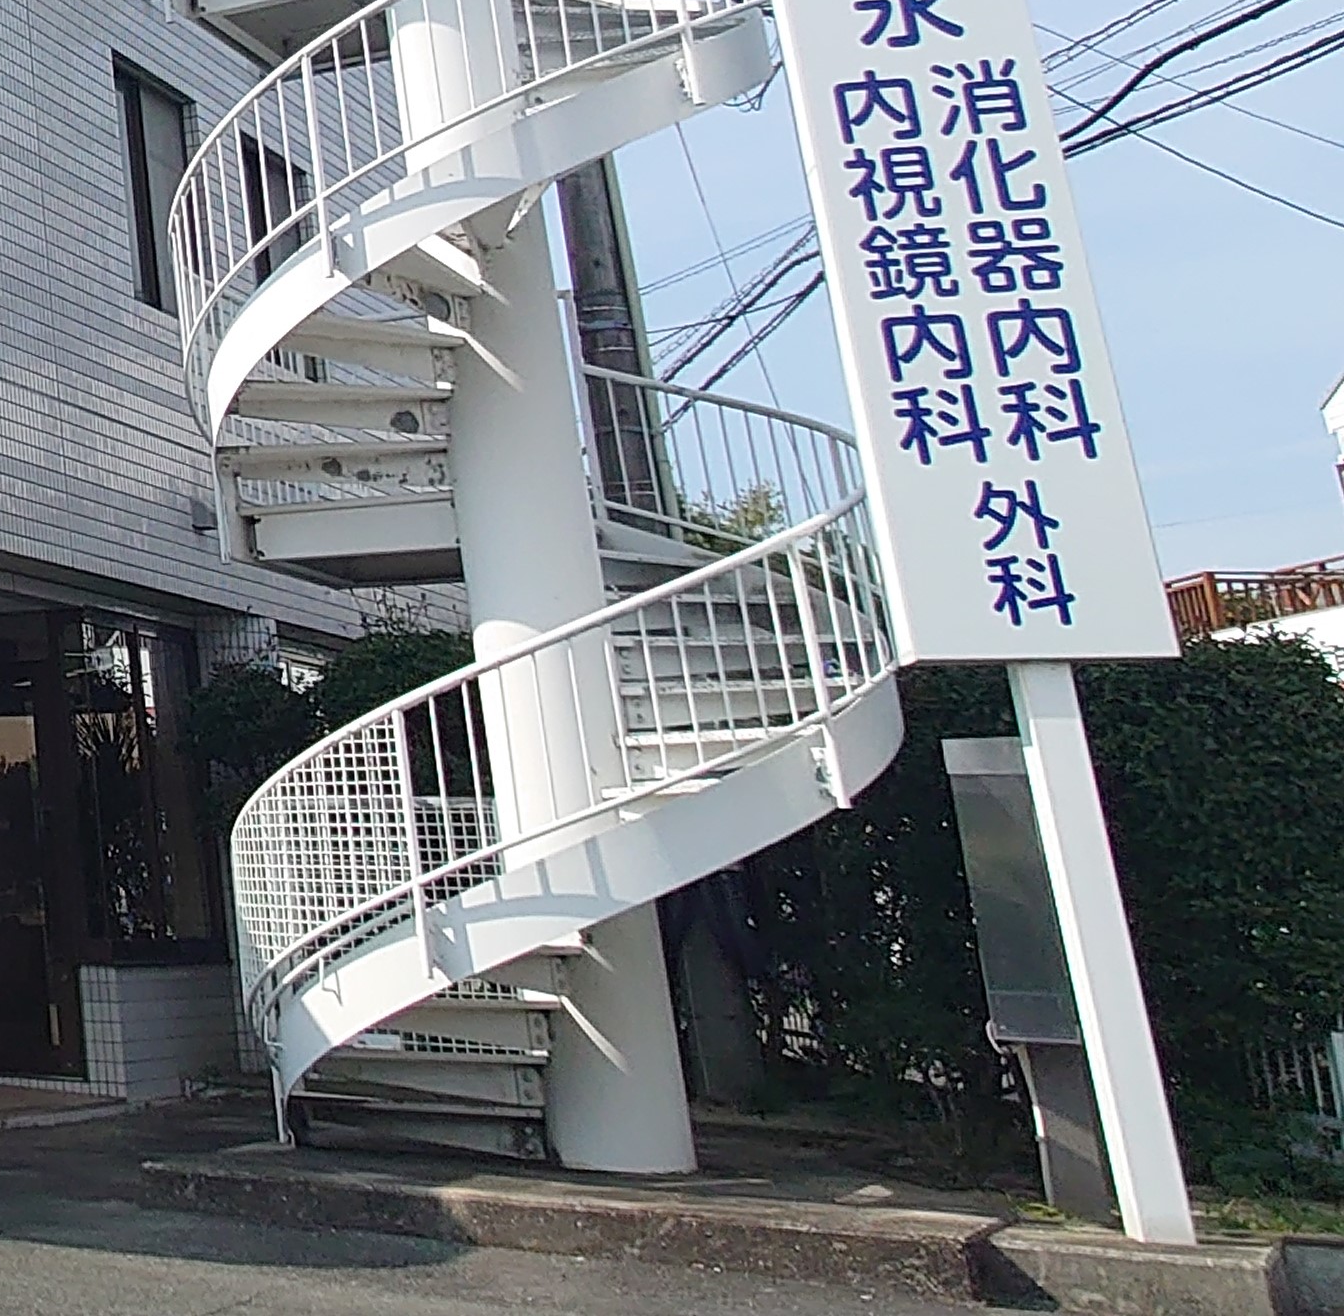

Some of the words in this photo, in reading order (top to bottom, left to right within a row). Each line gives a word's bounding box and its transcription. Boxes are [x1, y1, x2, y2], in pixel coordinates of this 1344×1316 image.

[834, 70, 991, 466] 内視鏡内科
[930, 58, 1102, 462] 消化器内科
[973, 481, 1076, 627] 外科
